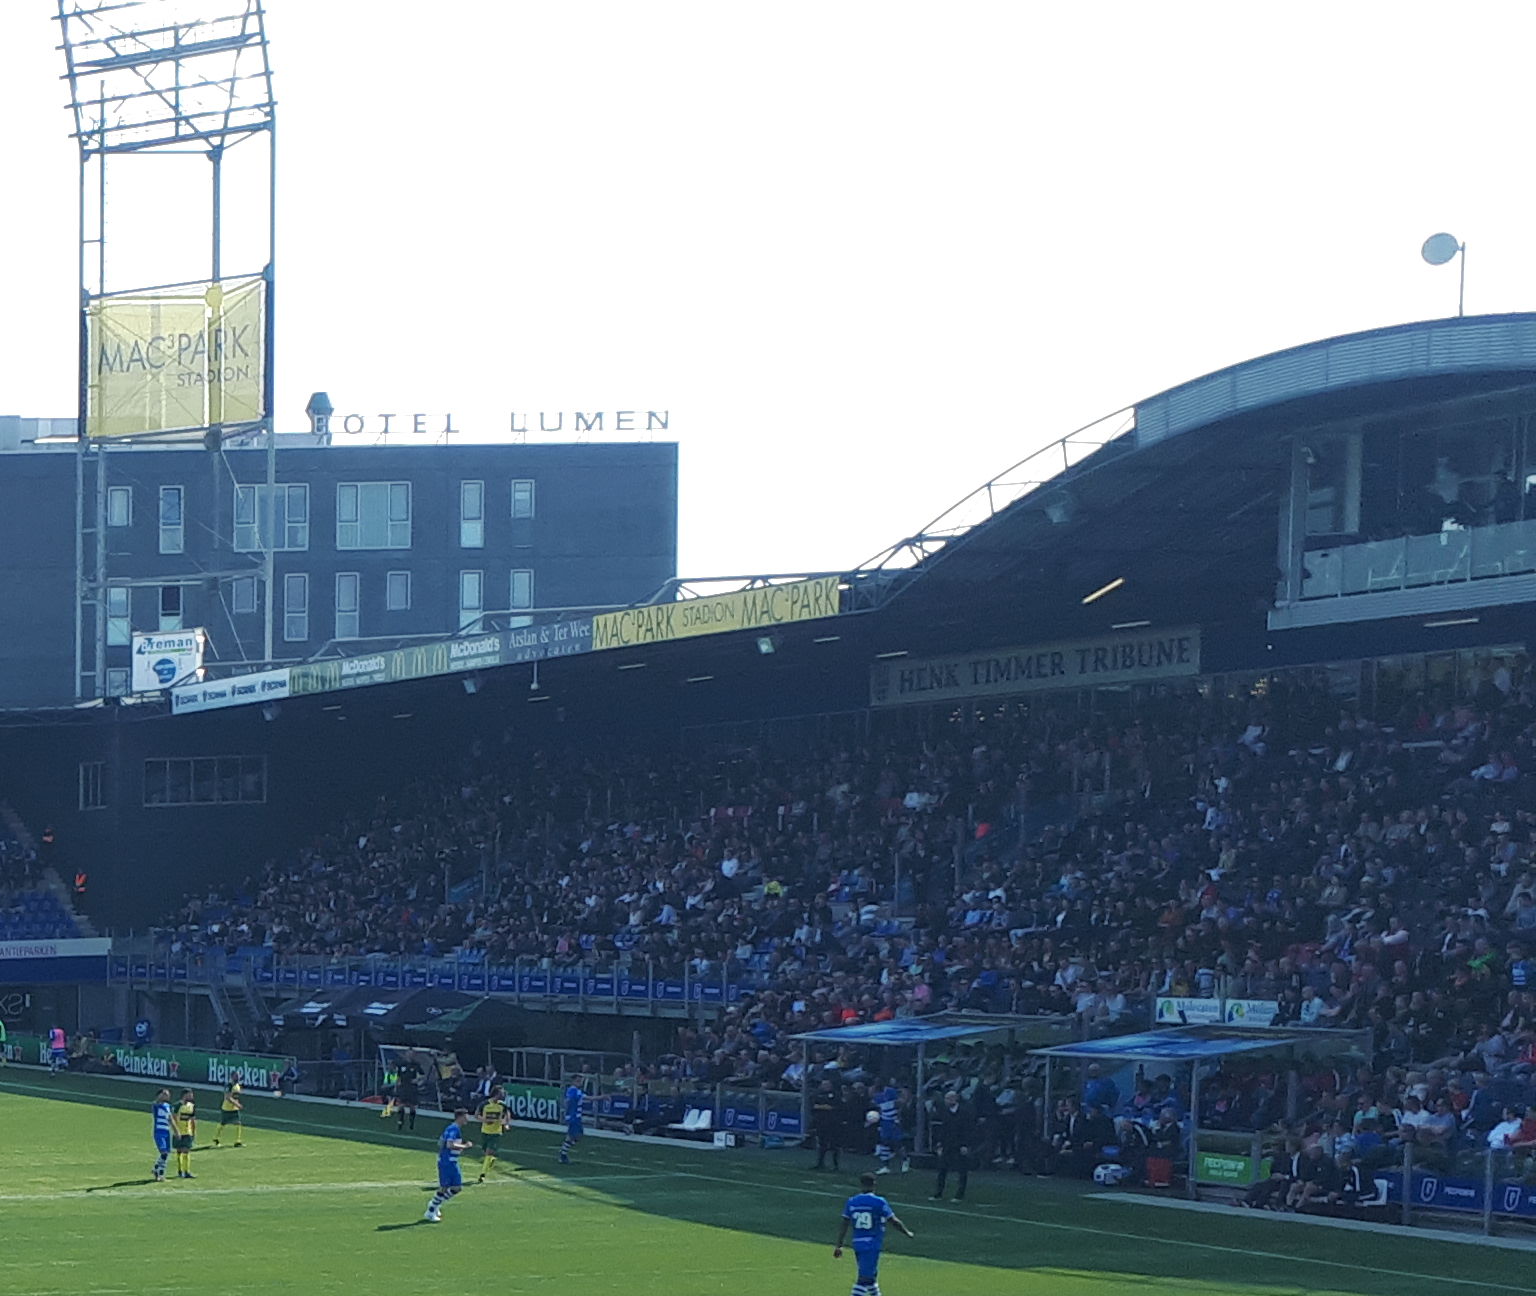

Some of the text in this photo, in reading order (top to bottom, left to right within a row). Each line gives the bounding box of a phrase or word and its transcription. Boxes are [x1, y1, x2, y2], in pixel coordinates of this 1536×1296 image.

[178, 364, 250, 387] STADION
[510, 410, 670, 433] LUMEN
[682, 600, 735, 628] STADION
[553, 624, 568, 641] Ter
[570, 620, 591, 639] Wee
[140, 637, 194, 650] Breman
[450, 637, 501, 659] McDonald's
[341, 656, 386, 675] McDonald's
[898, 635, 1193, 695] HENK TIMMER TRIBUNE
[115, 1049, 168, 1077] Heineken
[207, 1058, 268, 1088] Heineken
